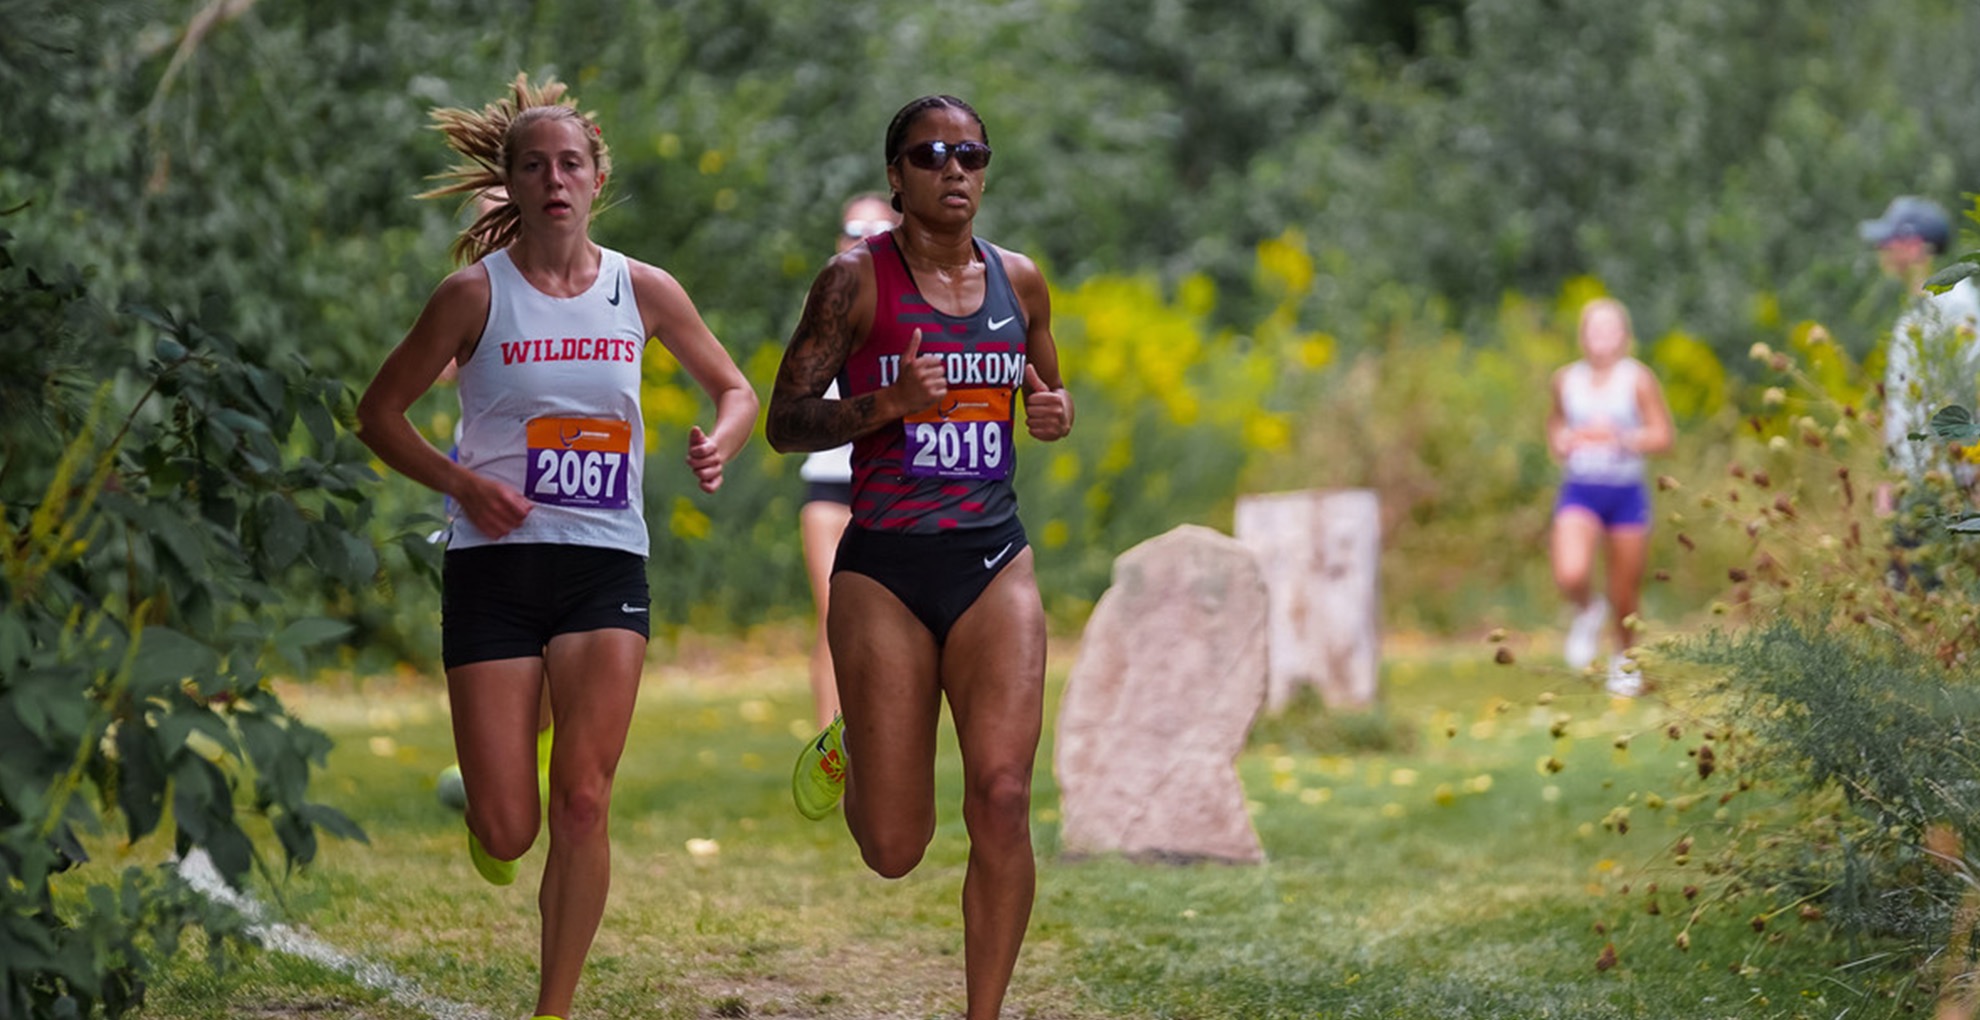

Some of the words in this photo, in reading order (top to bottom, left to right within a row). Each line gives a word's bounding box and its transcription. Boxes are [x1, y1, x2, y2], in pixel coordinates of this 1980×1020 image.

[501, 338, 635, 366] WILDCATS
[922, 352, 1026, 388] OKOM
[913, 421, 1001, 469] 2019
[534, 449, 621, 498] 2067
